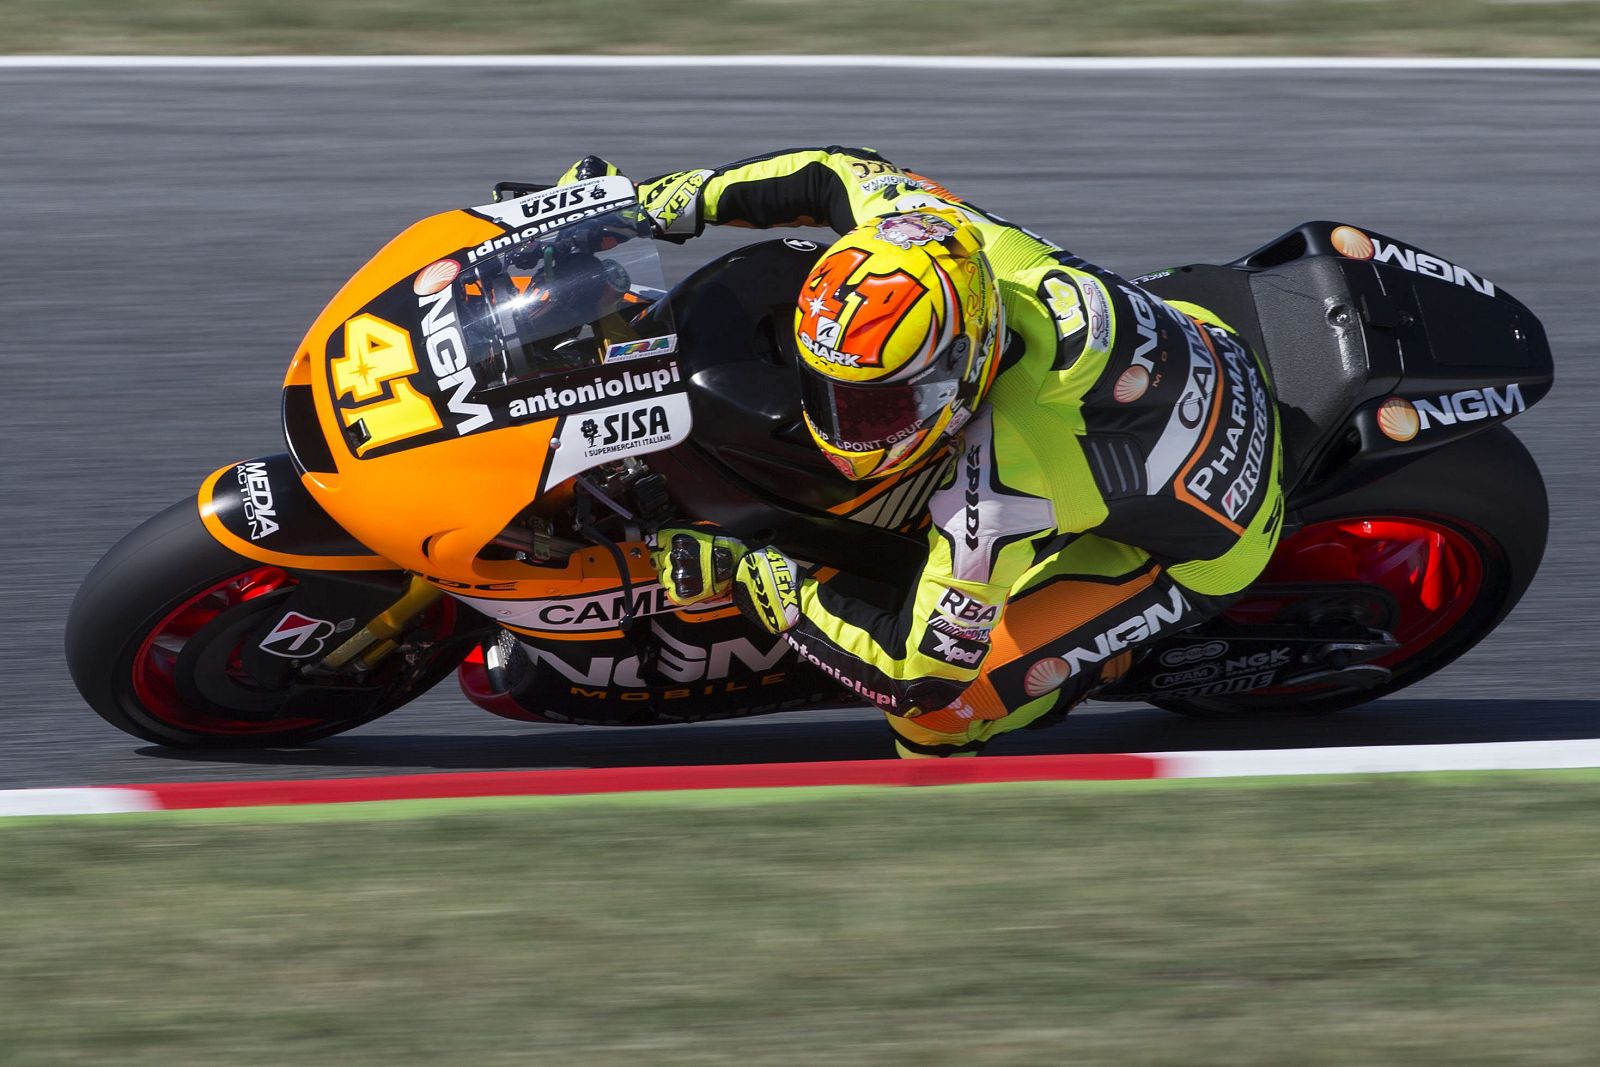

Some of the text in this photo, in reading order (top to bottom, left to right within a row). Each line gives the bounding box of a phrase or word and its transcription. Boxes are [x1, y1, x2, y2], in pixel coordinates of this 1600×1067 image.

[520, 187, 586, 218] SISA
[1371, 239, 1496, 298] NGM
[798, 246, 930, 369] 41
[419, 284, 494, 436] NGM
[800, 331, 863, 368] SHARK
[331, 312, 444, 458] 41
[508, 361, 681, 419] antoniolupi
[1411, 383, 1527, 430] NGM
[588, 440, 641, 457] SUPERMERCATI
[643, 433, 671, 446] ITALIANI
[603, 405, 670, 445] SISA
[886, 419, 924, 445] GRUP
[236, 465, 261, 541] ACTION
[245, 462, 280, 539] MEDIA
[940, 587, 997, 623] RBA
[1062, 585, 1191, 677] NGM
[1163, 668, 1209, 685] AFAM
[1226, 647, 1292, 673] NGK
[570, 672, 787, 701] MOBILE
